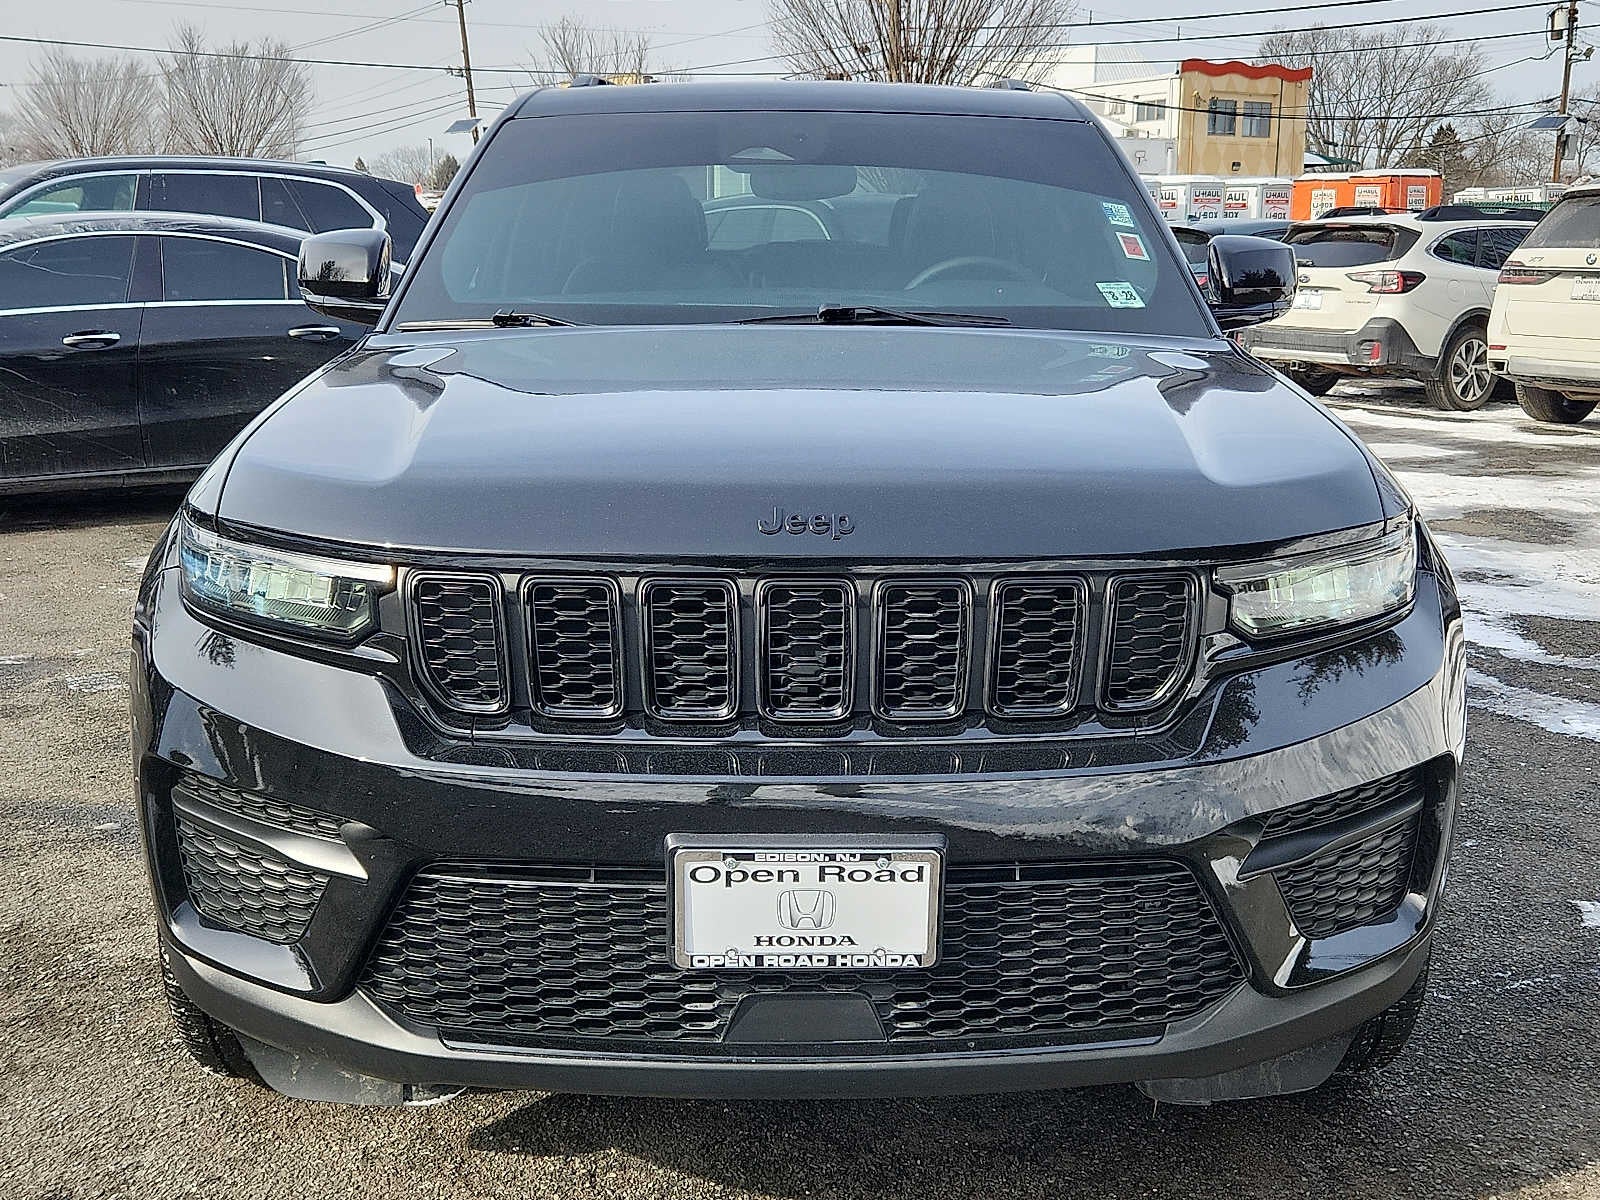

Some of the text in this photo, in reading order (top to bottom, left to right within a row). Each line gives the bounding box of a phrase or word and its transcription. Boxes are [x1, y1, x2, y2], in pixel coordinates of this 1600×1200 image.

[1194, 190, 1221, 198] U-HAUL
[756, 505, 856, 541] Jeep
[832, 853, 861, 862] NJ
[689, 865, 925, 888] Open Road
[753, 935, 859, 947] HONDA
[692, 954, 919, 968] OPEN ROAD HONDA
